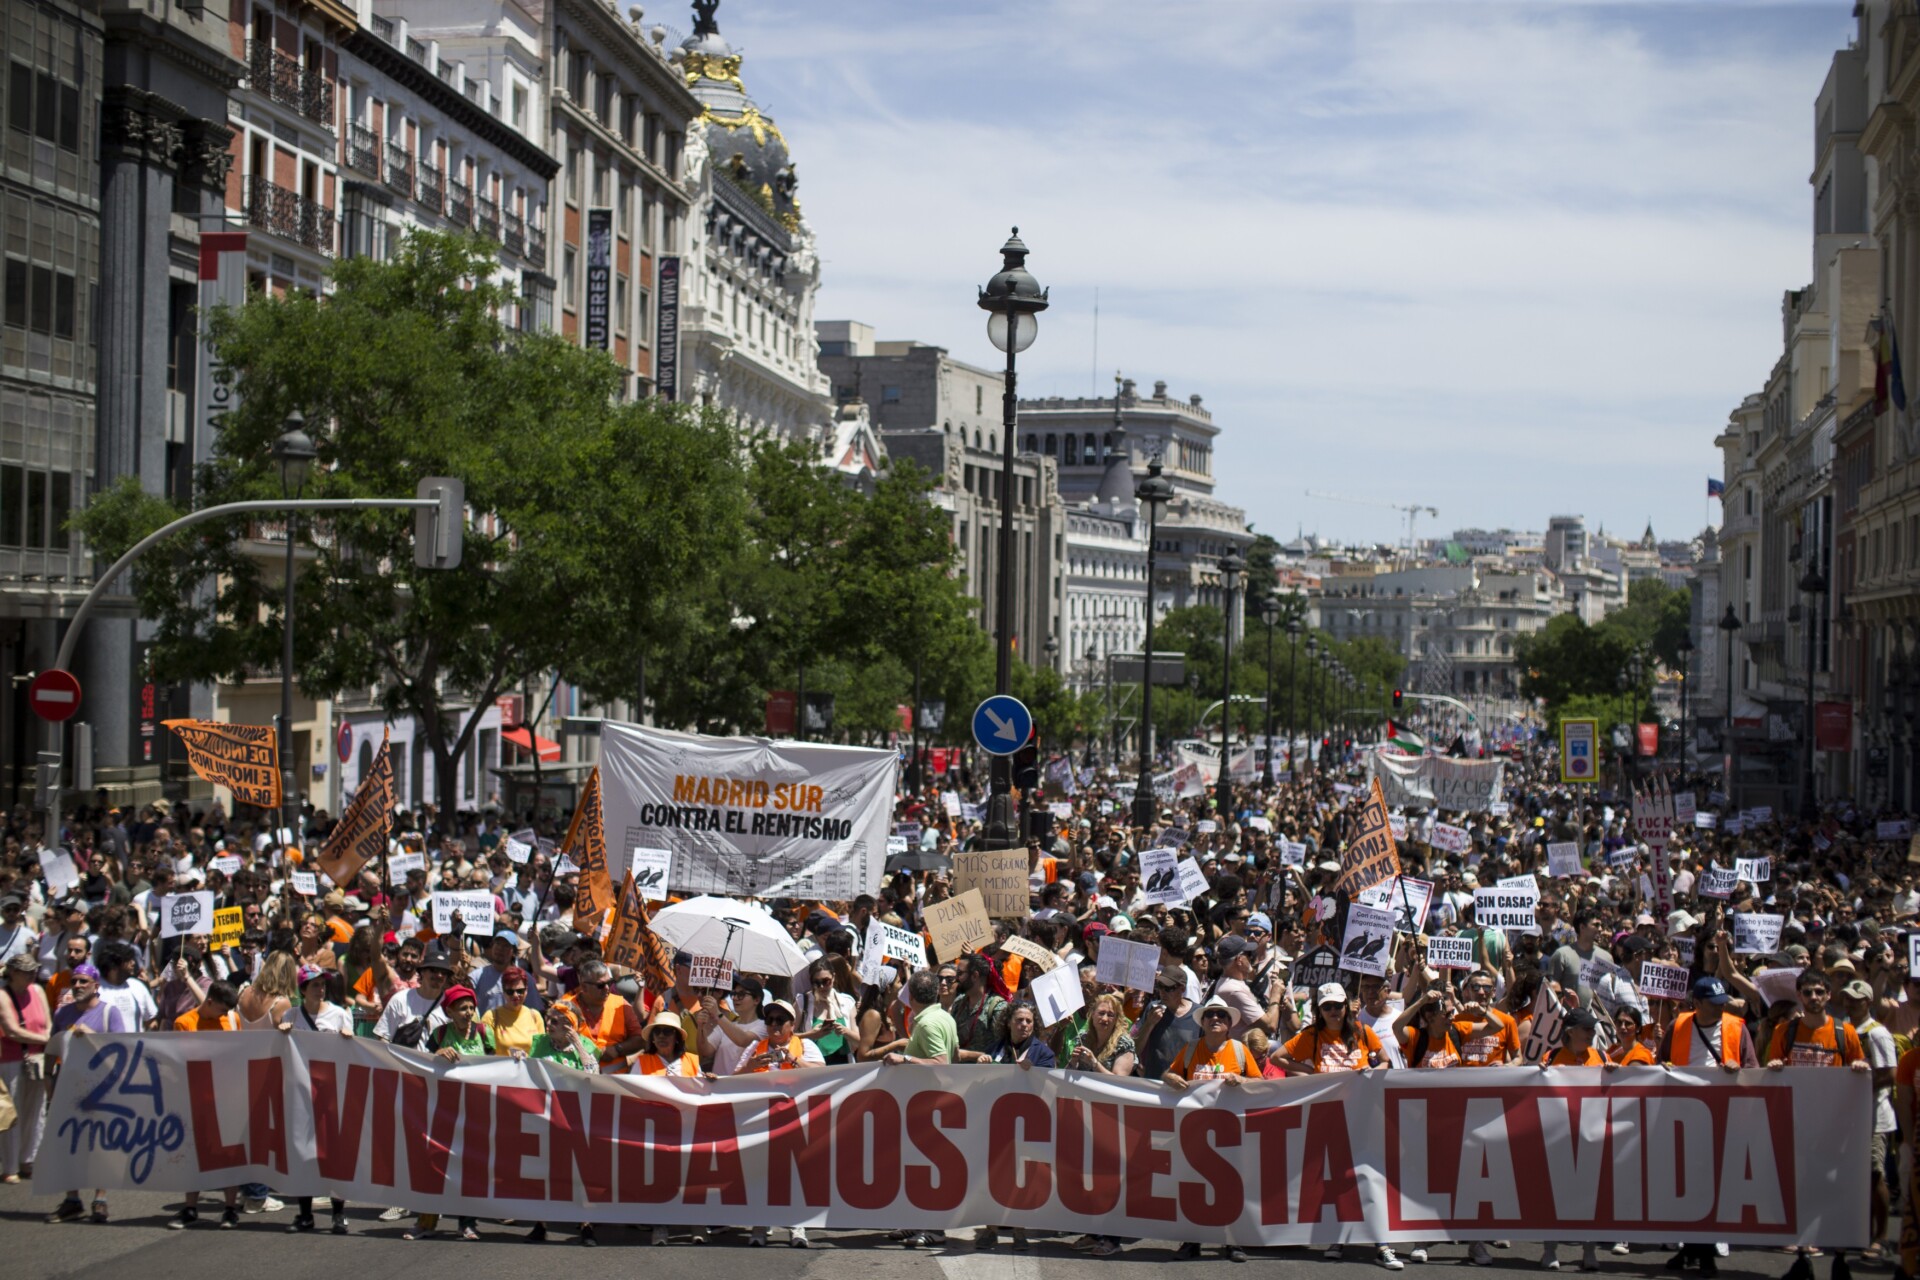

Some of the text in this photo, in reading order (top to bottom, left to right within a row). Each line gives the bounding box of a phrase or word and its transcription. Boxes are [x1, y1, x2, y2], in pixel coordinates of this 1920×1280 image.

[660, 277, 678, 387] NOS QUEREMOS VIVAS
[672, 774, 825, 813] MADRID SUR
[640, 803, 852, 841] CONTRA EL RENTISMO
[1638, 816, 1673, 829] FUCK
[1757, 861, 1769, 880] NO
[968, 877, 1020, 890] Y MENOS
[173, 902, 199, 915] STOP
[440, 897, 491, 910] No hipoteques
[1476, 896, 1533, 908] SIN CASA?
[440, 913, 447, 921] tu
[937, 899, 967, 924] PLAN
[1356, 911, 1369, 919] Con
[1486, 914, 1499, 926] LA
[1501, 914, 1533, 927] CALLE!
[887, 944, 893, 955] A
[1429, 939, 1472, 951] DERECHO
[1429, 950, 1471, 961] A TECHO
[693, 956, 733, 971] DERECHO
[1343, 958, 1363, 968] FONDOS
[691, 967, 732, 982] A TECHO
[1643, 964, 1688, 982] DERECHO
[1642, 976, 1686, 993] A TECHO
[78, 1040, 165, 1119] 24
[58, 1110, 185, 1185] mayo
[187, 1057, 1788, 1227] LA VIVIENDA NOS CUESTA LA VIDA
